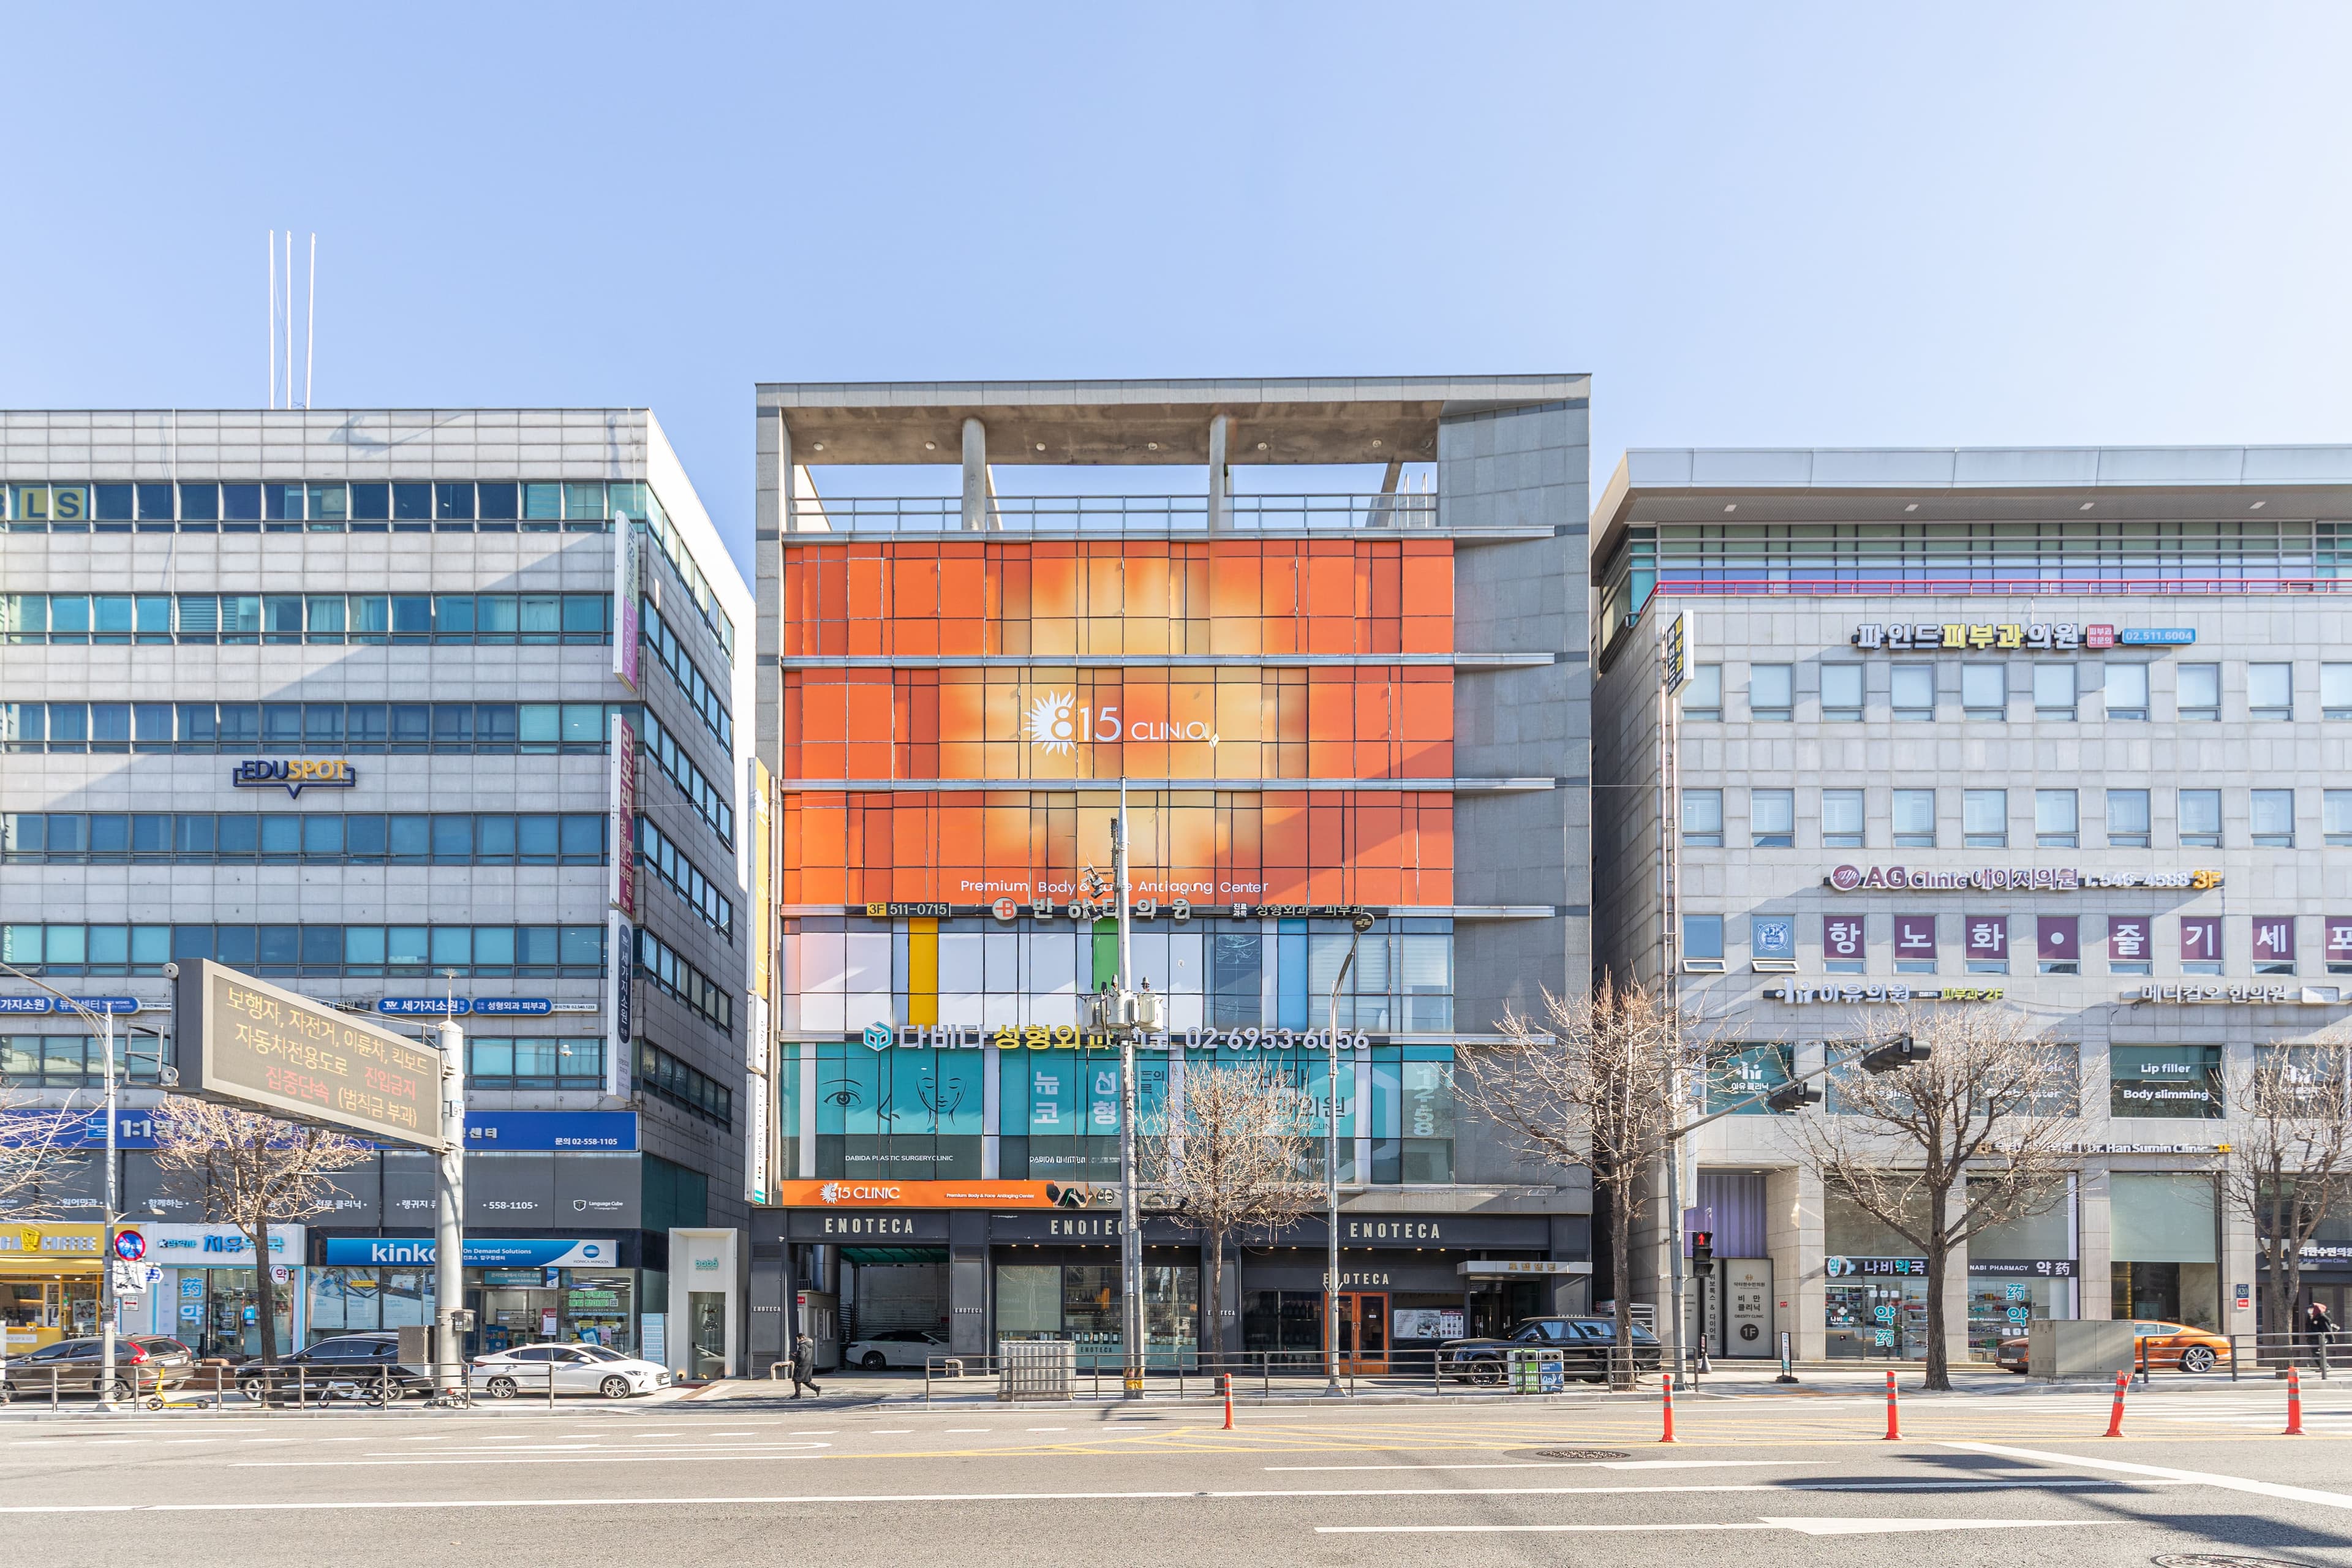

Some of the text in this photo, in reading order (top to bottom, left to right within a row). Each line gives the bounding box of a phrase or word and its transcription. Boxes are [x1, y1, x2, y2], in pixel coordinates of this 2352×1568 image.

[2125, 631, 2192, 642] 02.511.6004
[241, 760, 349, 779] EDUSPOT
[1863, 865, 1968, 890] AG Clinic
[2192, 869, 2222, 890] 3F
[961, 880, 1030, 892] Premium
[1039, 881, 1076, 896] Body
[1220, 880, 1268, 893] Center
[869, 903, 948, 915] 3F 511-0715
[1819, 983, 1910, 1004] 이유의원
[2227, 984, 2288, 1004] 한의원
[401, 1000, 459, 1012] 세가지소원
[487, 1001, 547, 1011] 성형외과 피부과
[226, 987, 428, 1076] 보행자, 자전거, 이륜차, 킥보드
[235, 1023, 417, 1101] 자동차전용도로 진입금지
[2140, 1063, 2191, 1075] Lip filler
[266, 1065, 417, 1128] 집중단속 (범칙금 부과)
[2123, 1088, 2209, 1102] Body slimming
[555, 1137, 618, 1145] 문의 02-558-1105
[853, 1186, 900, 1200] CLINIC
[148, 1199, 184, 1208] 함께하는
[335, 1200, 361, 1209] 클리닉
[401, 1199, 428, 1210] 랭귀지
[489, 1201, 533, 1210] 558-1105
[824, 1218, 914, 1234] ENOTECA
[1350, 1223, 1440, 1238] ENOTECA
[42, 1237, 97, 1251] COFFEE
[2298, 1246, 2352, 1257] 터한수민의원
[372, 1243, 436, 1264] kinko
[1830, 1259, 1839, 1274] 약
[1864, 1259, 1925, 1275] 나비약국
[2036, 1261, 2052, 1276] 약
[2055, 1262, 2070, 1275] 药
[1323, 1272, 1389, 1285] EOTECA
[180, 1277, 203, 1298] 药
[2006, 1283, 2026, 1301] 药
[179, 1304, 205, 1325] 약
[1874, 1305, 1896, 1326] 약
[2007, 1306, 2029, 1327] 약
[1743, 1327, 1757, 1337] 1F
[1875, 1329, 1895, 1348] 药
